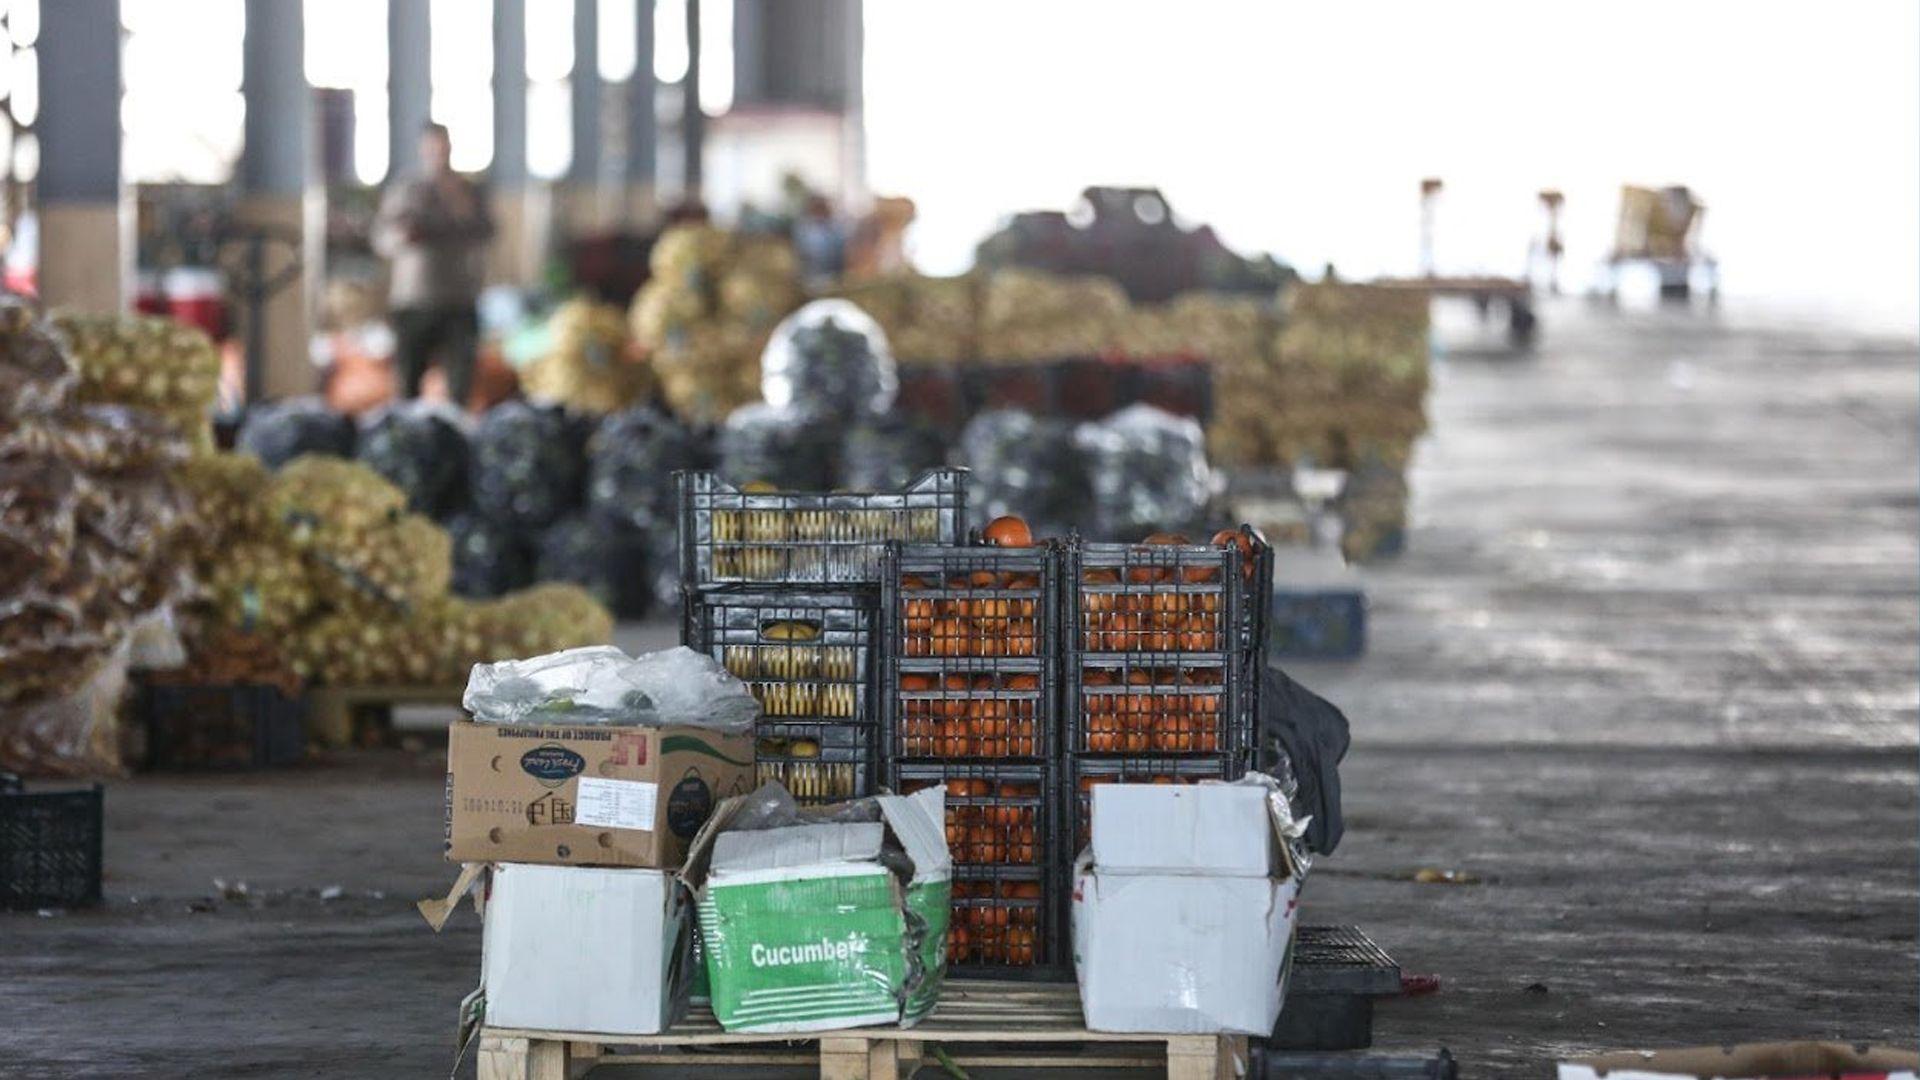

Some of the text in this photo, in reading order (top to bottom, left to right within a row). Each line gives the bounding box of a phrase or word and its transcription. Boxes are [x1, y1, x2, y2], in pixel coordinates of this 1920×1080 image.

[497, 727, 611, 741] PRODUCT OF THE PHILIPPINES
